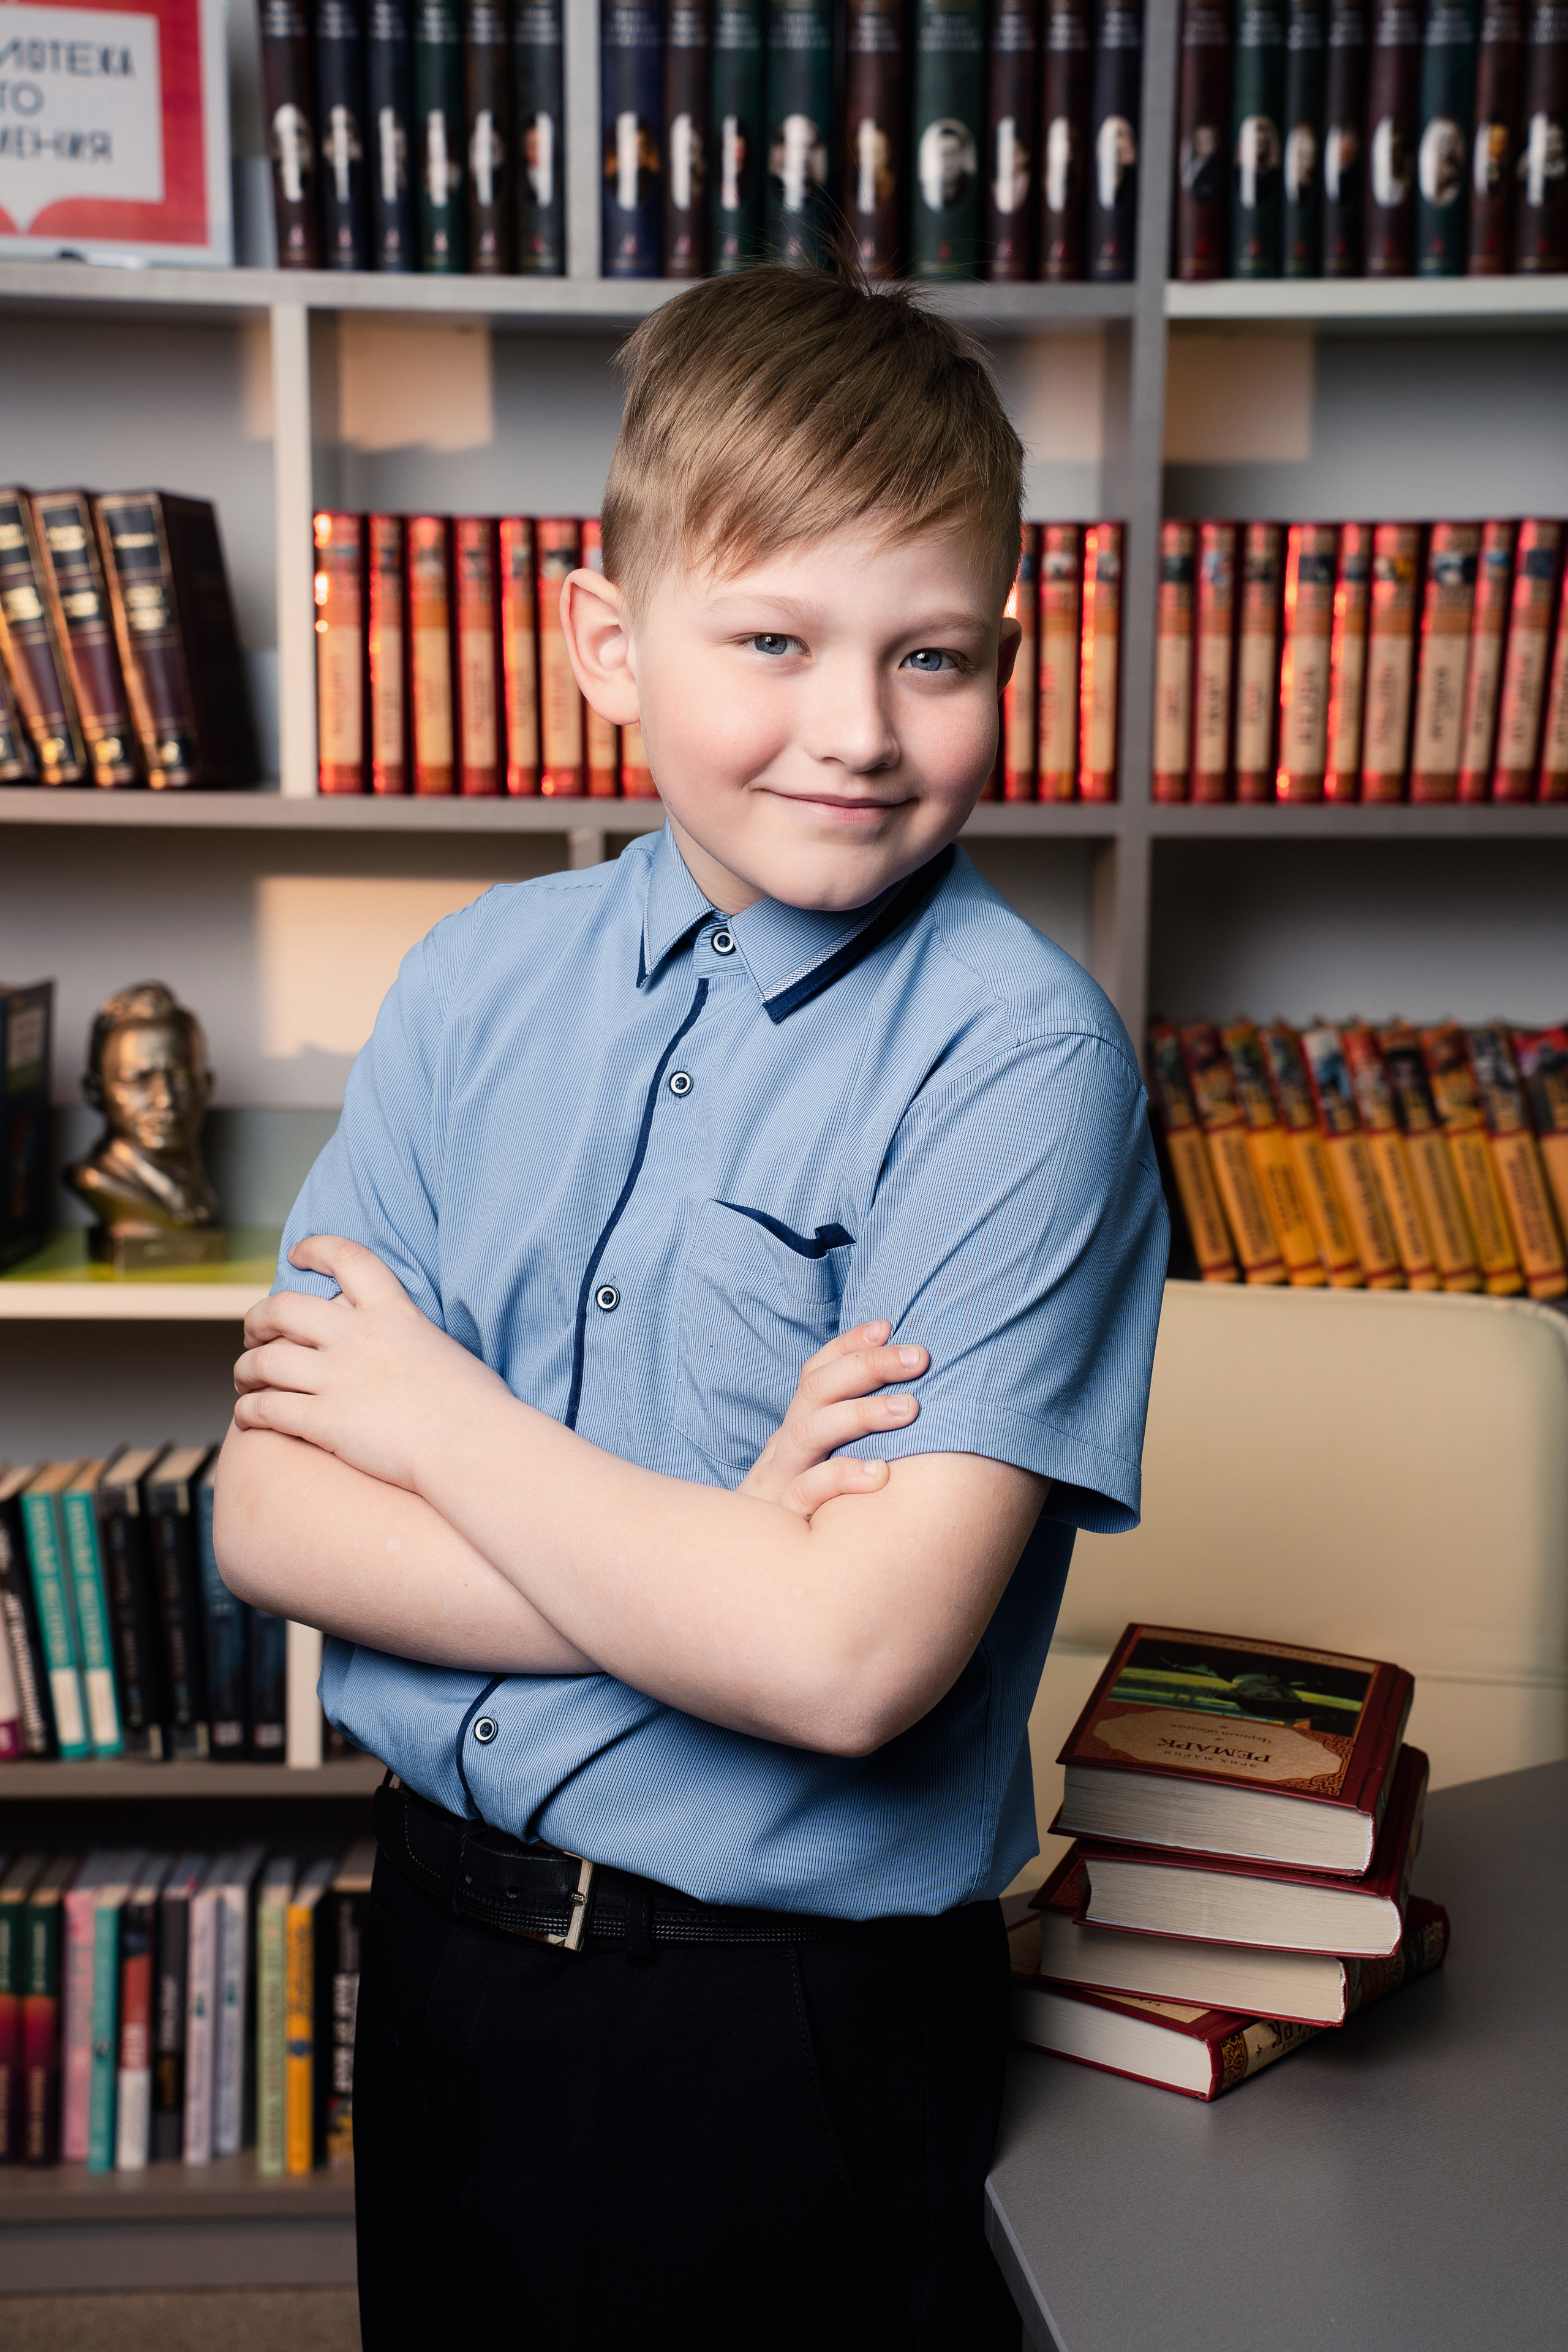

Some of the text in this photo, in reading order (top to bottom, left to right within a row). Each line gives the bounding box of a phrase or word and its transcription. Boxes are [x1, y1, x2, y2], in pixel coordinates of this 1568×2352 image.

[1157, 1738, 1272, 1763] РЕМАРК
[1164, 1750, 1257, 1768] ЭРИХ МАРИЯ
